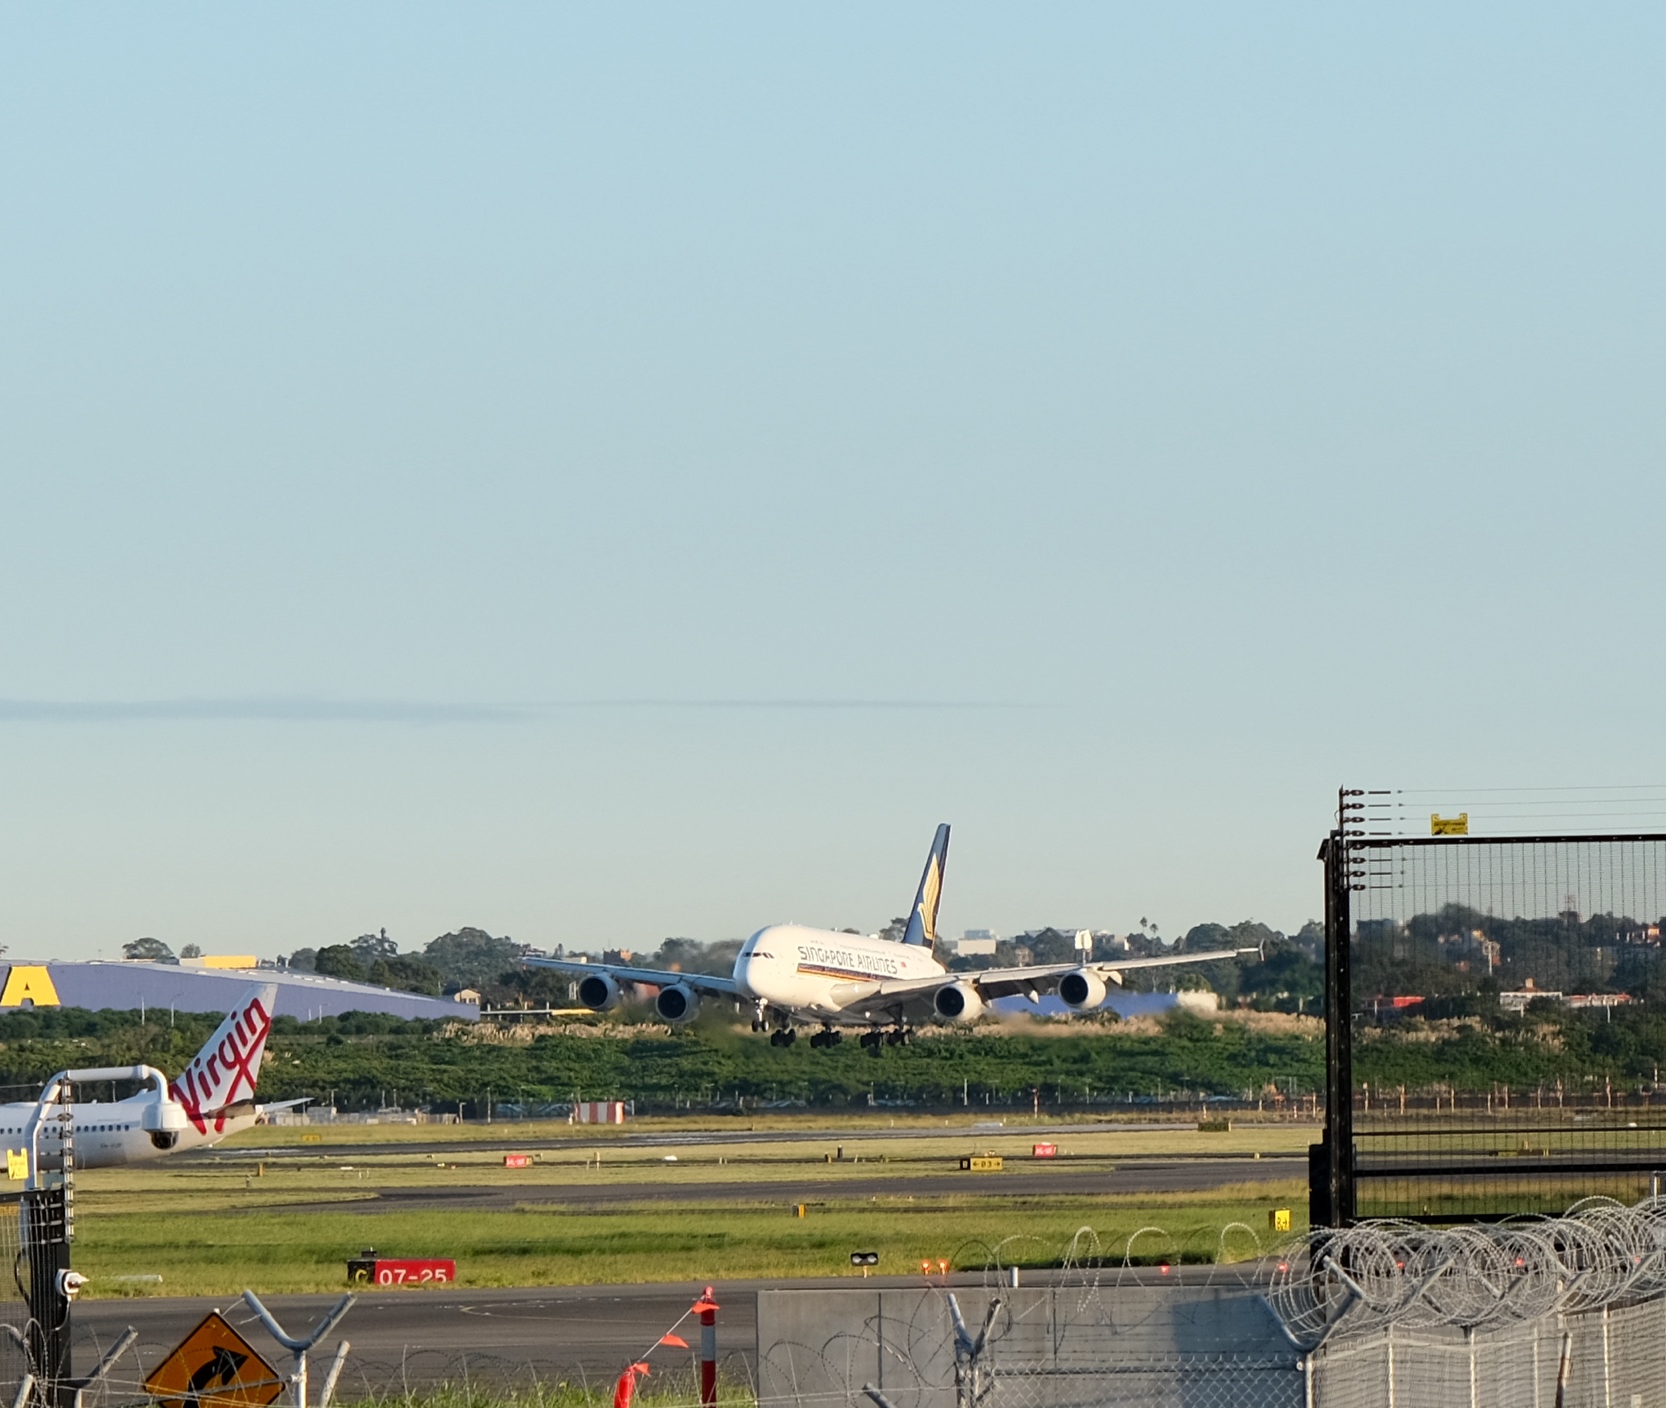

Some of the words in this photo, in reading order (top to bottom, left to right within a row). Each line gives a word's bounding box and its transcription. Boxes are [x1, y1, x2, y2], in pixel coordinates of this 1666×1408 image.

[797, 946, 855, 967] SINGAPORE
[857, 954, 898, 974] AIRLINES
[169, 997, 271, 1136] Virgin
[379, 1269, 447, 1285] 07-25
